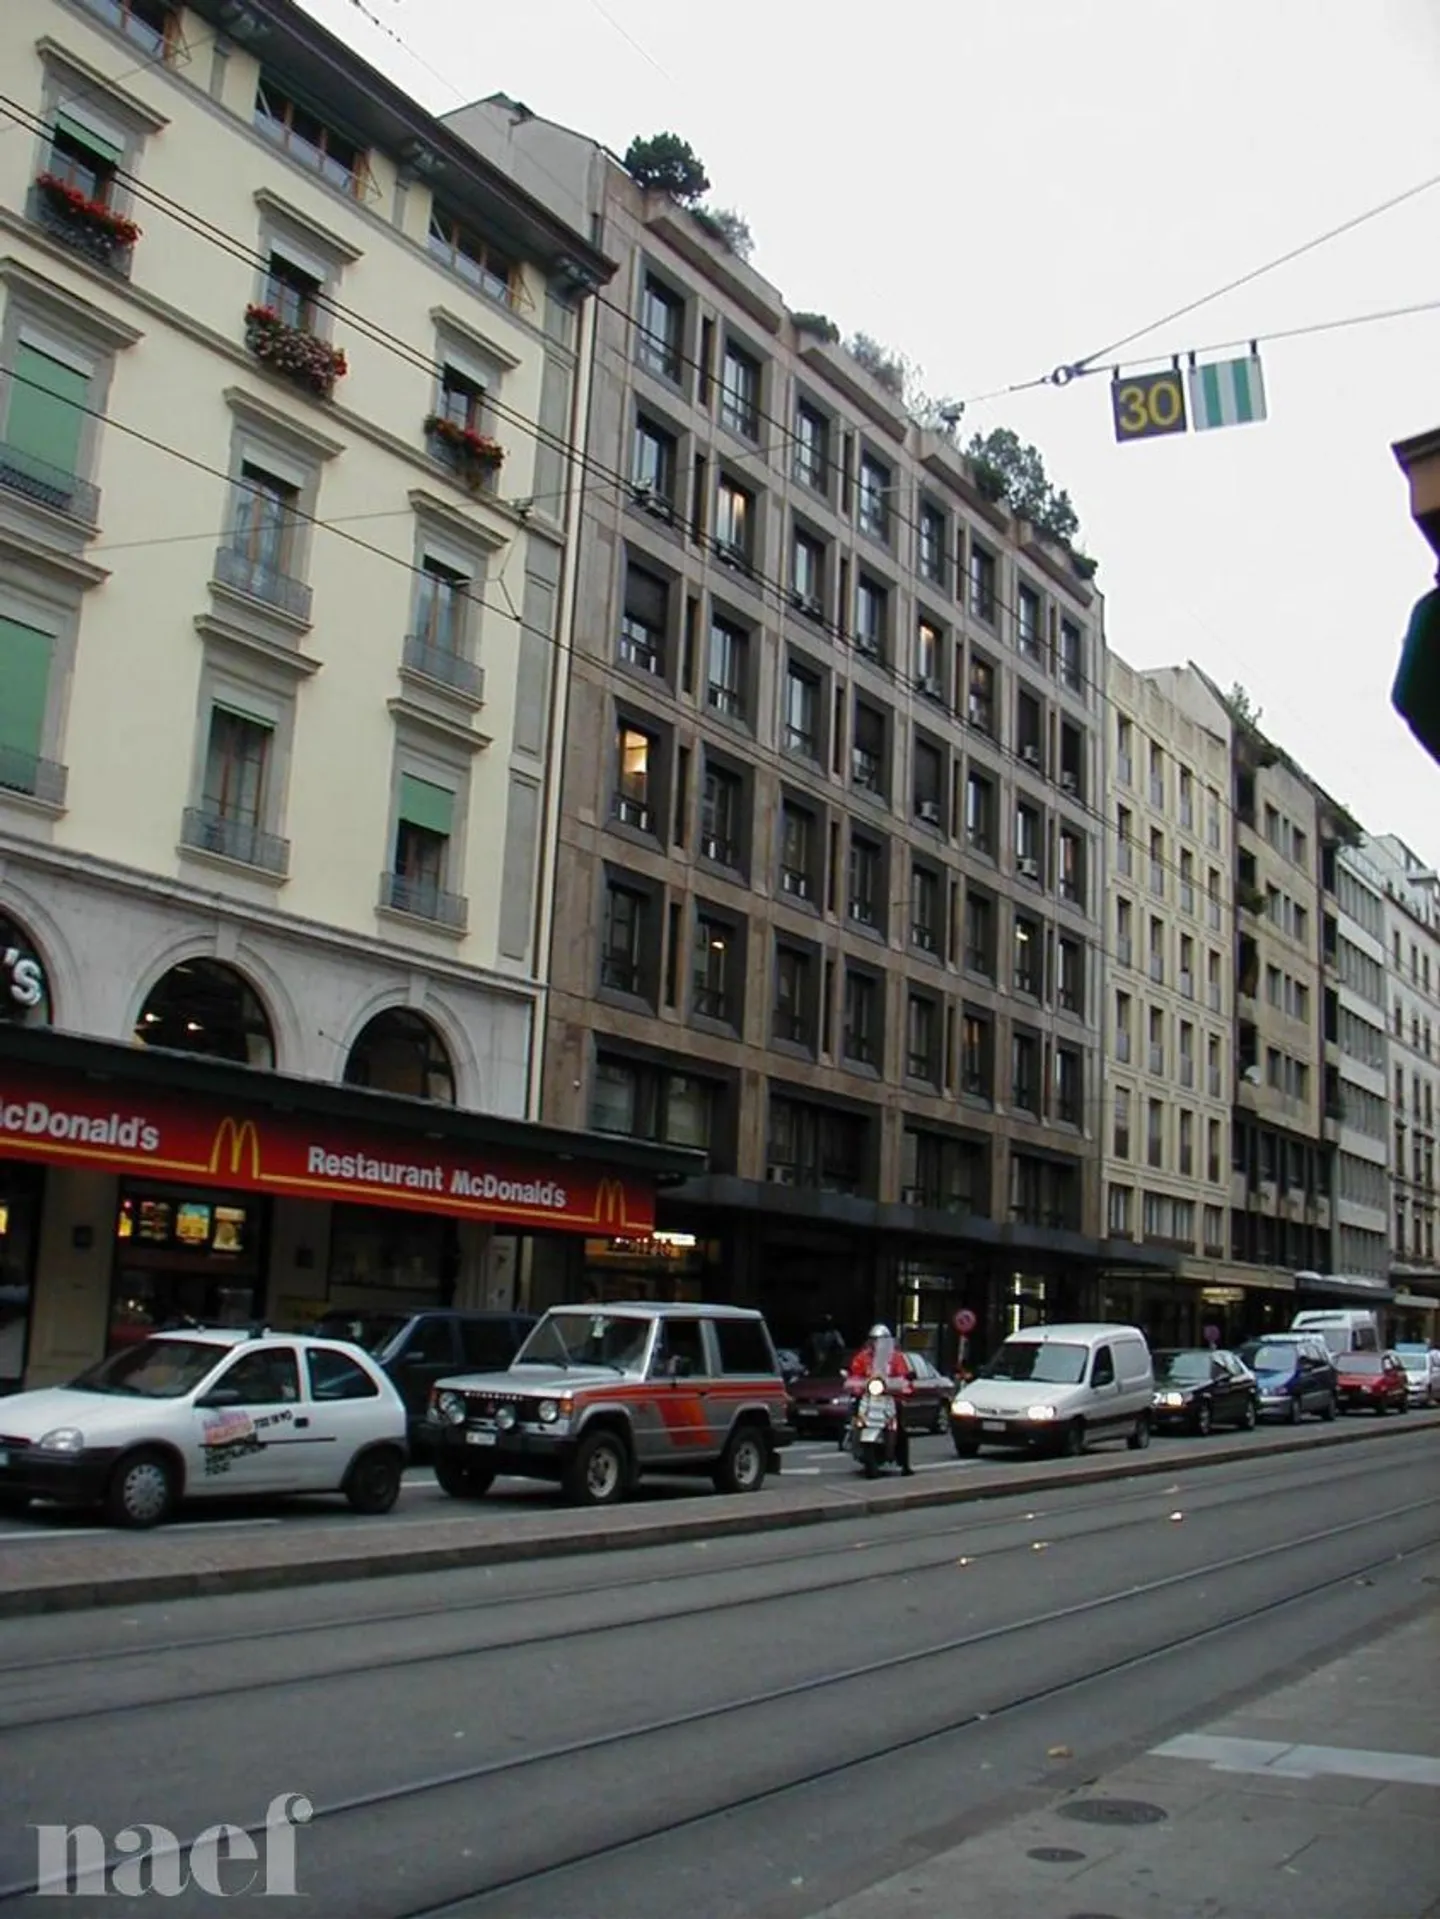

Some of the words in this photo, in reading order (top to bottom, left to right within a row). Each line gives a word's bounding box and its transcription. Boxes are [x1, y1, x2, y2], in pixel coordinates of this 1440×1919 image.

[1118, 380, 1182, 433] 30
[307, 1146, 444, 1191] Restaurant
[450, 1169, 567, 1209] McDonald's
